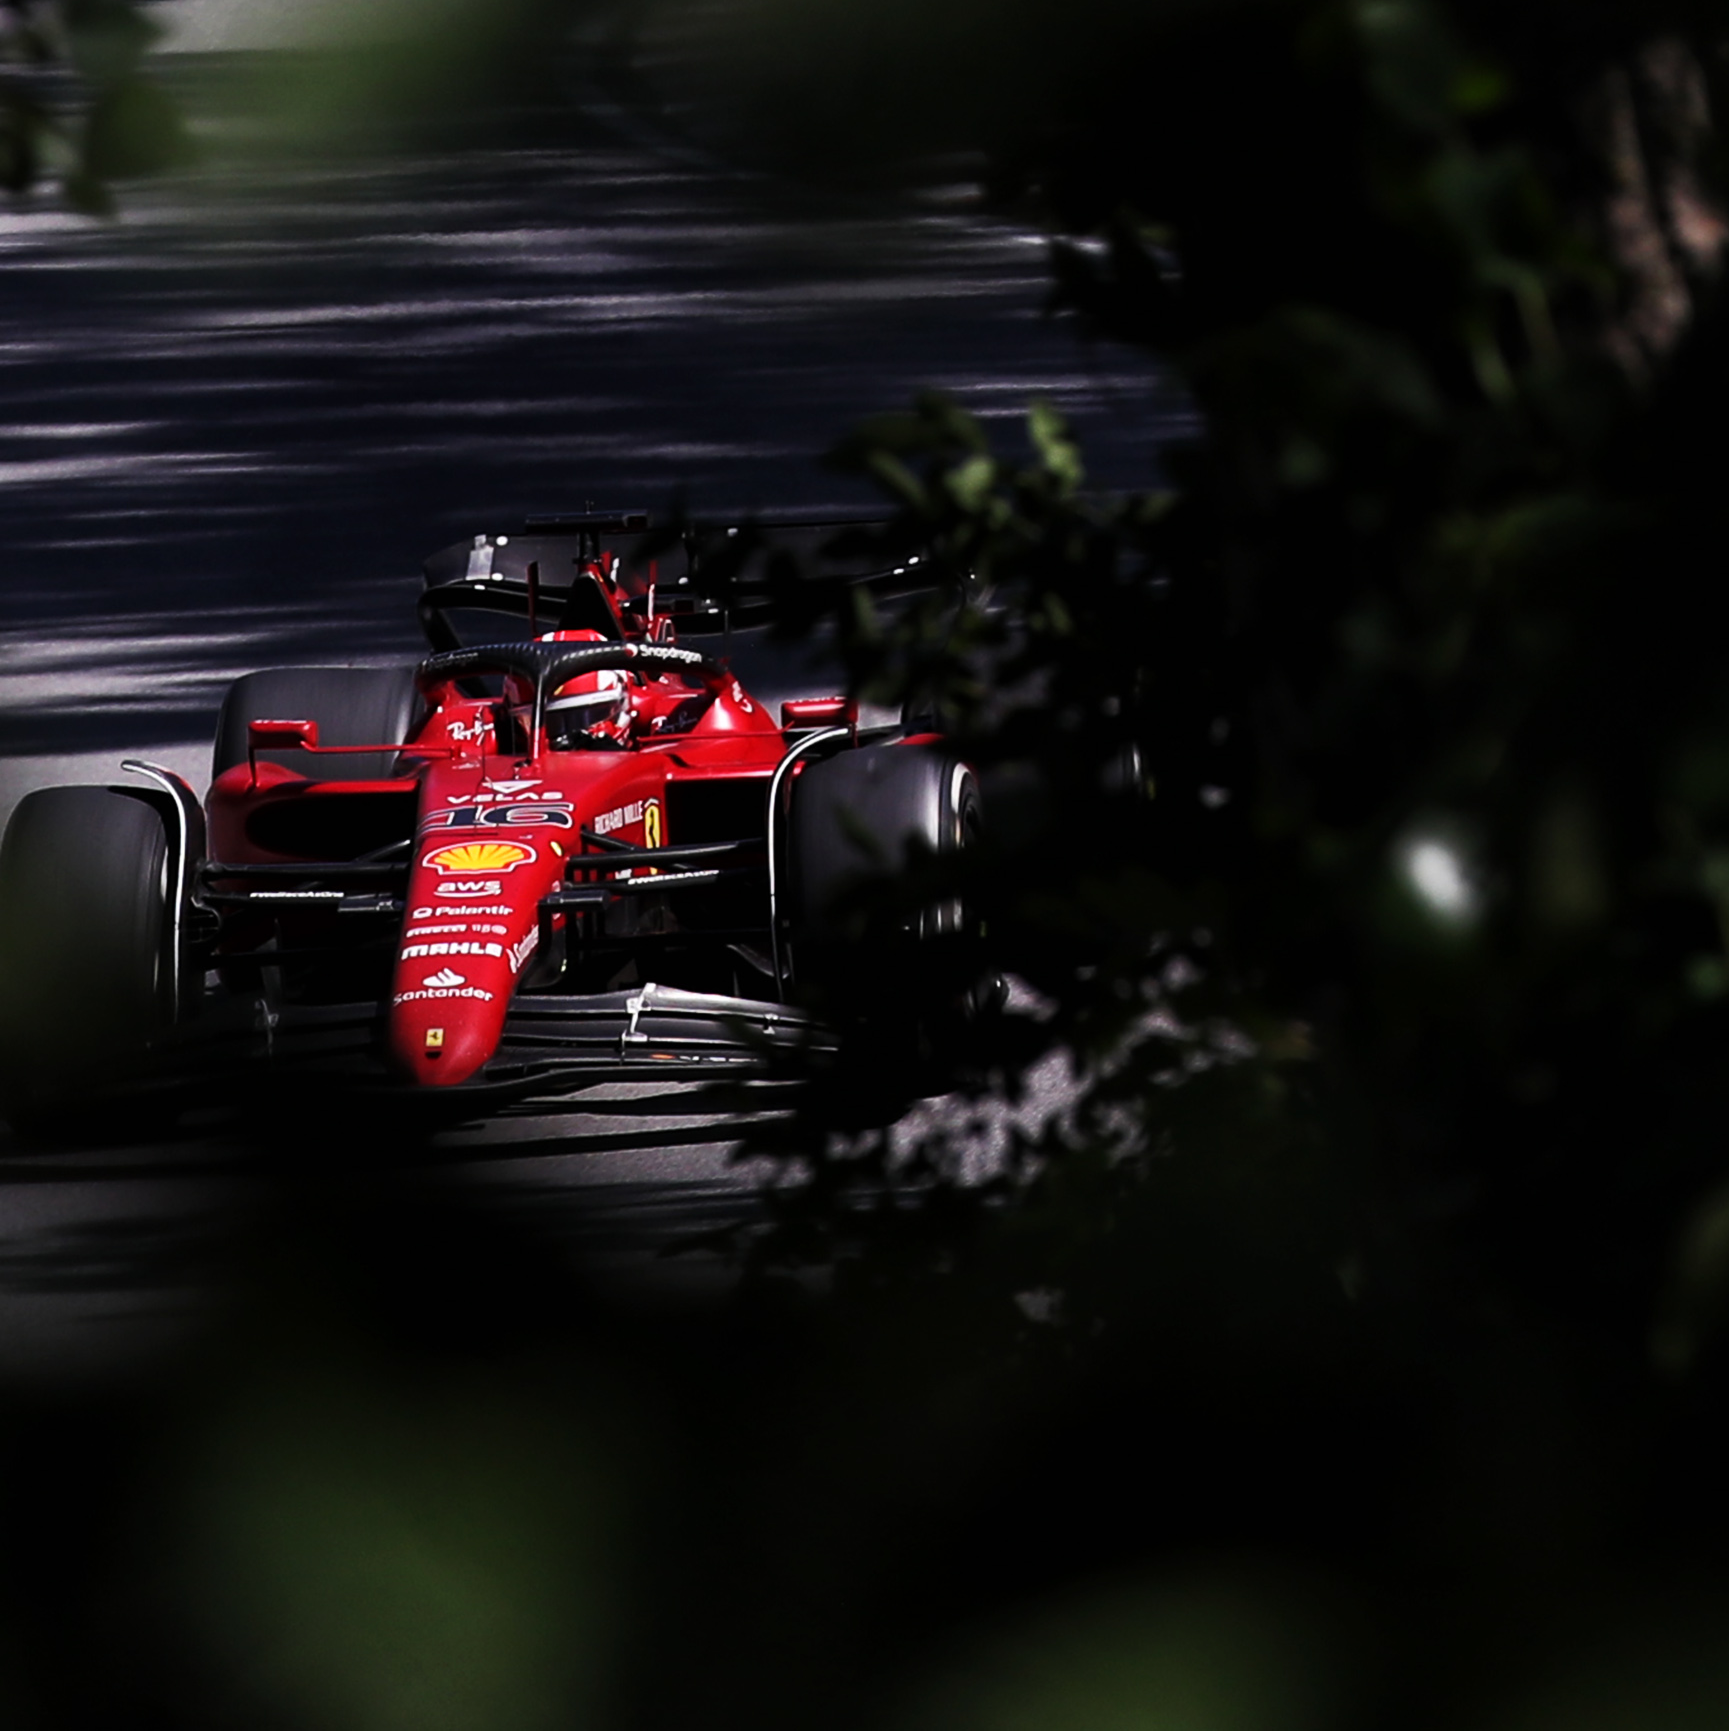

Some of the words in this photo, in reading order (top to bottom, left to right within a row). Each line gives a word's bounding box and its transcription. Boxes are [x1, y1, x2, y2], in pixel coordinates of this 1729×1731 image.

[638, 643, 703, 664] Snapdragon
[446, 791, 564, 805] VELAS
[420, 802, 575, 836] 16
[436, 880, 511, 895] aws
[434, 904, 514, 918] Palantir
[400, 941, 504, 961] MAHLE
[392, 986, 494, 1008] Santander
